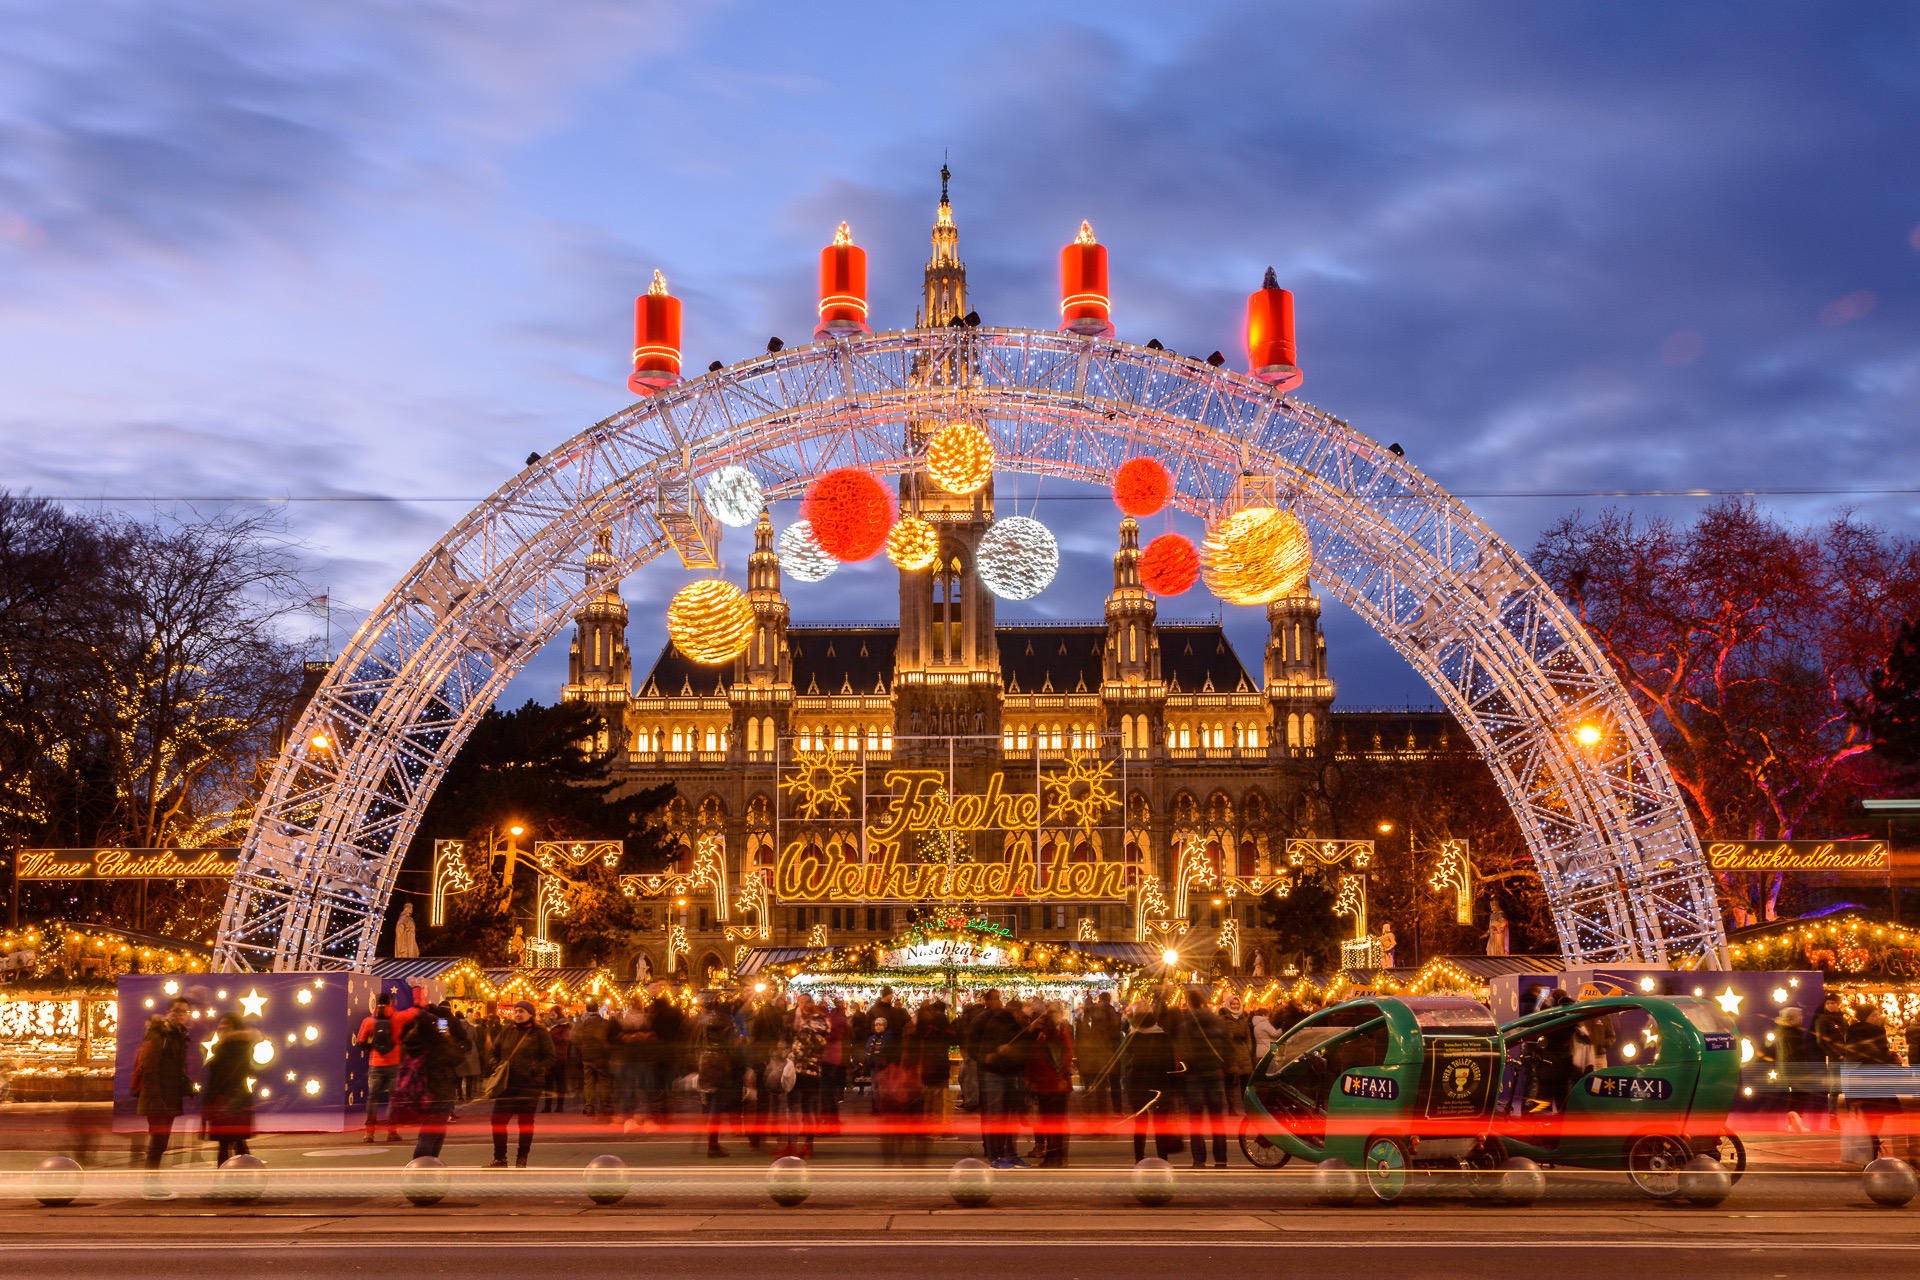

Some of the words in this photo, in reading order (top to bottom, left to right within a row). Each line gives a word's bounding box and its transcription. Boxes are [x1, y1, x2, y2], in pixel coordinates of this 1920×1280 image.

[866, 769, 1041, 842] Frohe
[19, 852, 91, 876] Wiener
[95, 850, 238, 875] Christkindlma
[1709, 843, 1888, 869] Christkindlmarkt
[776, 839, 1127, 901] Weihnachten
[1361, 1077, 1392, 1093] FAXI
[1618, 1078, 1662, 1093] FAXI
